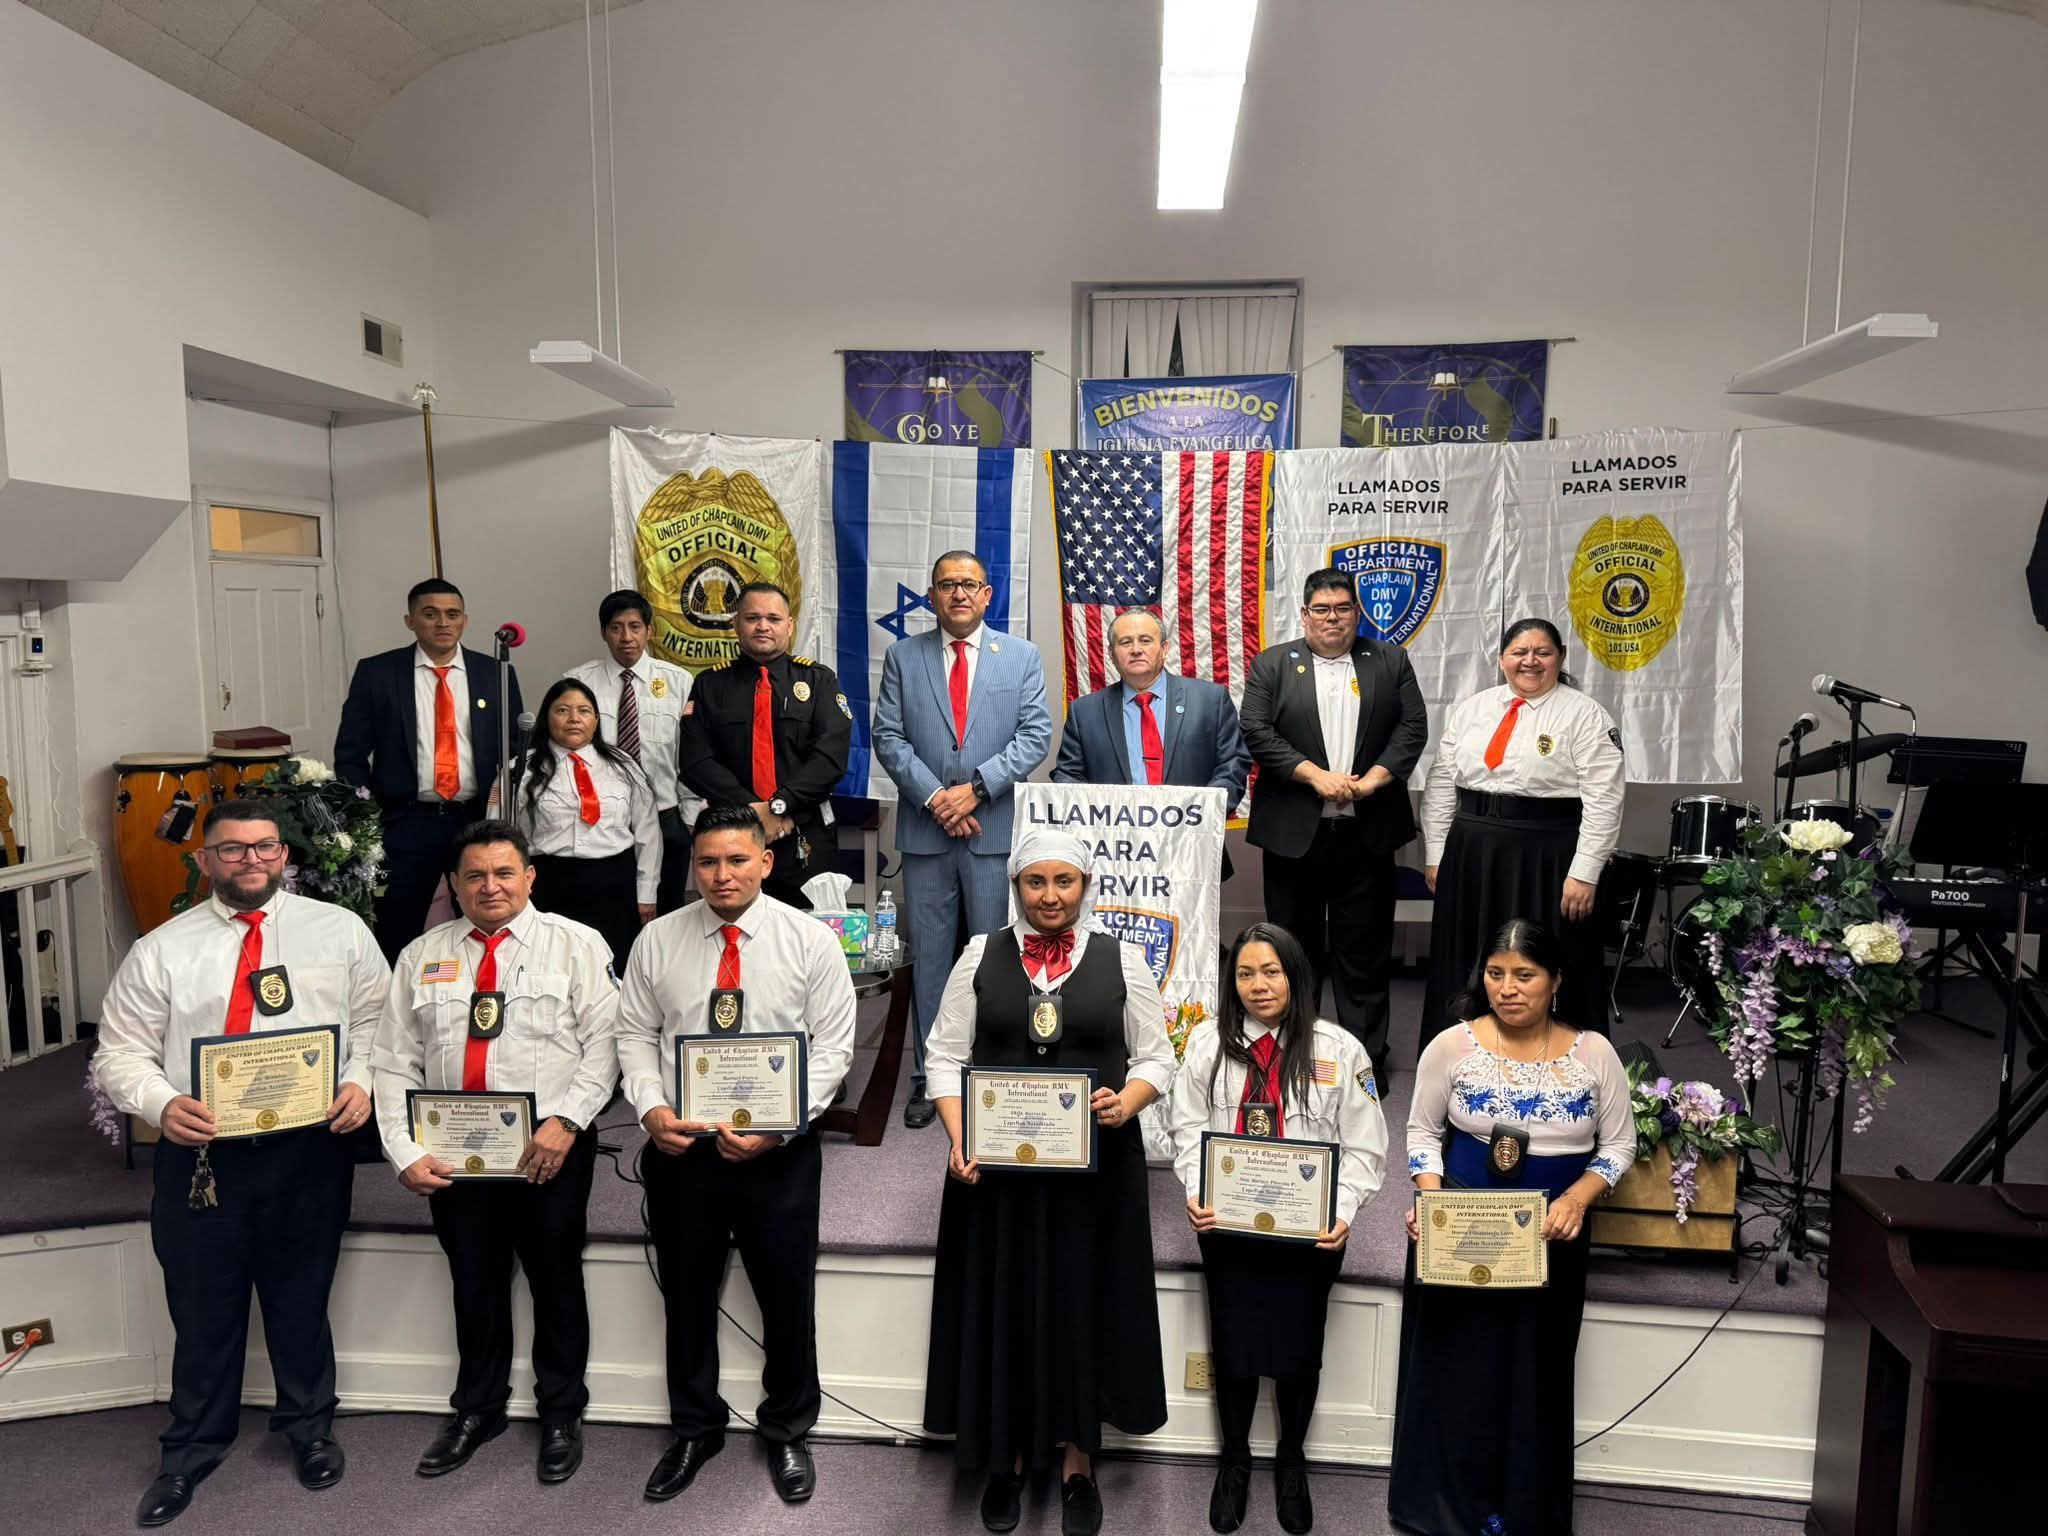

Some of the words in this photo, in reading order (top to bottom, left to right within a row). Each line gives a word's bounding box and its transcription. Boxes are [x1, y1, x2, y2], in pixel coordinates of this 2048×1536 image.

[1093, 386, 1280, 428] BIENVENIDOS
[1168, 415, 1178, 428] A
[1184, 415, 1204, 428] LA
[1097, 436, 1165, 451] IGLESIA
[1571, 455, 1678, 474] LLAMADOS
[1338, 479, 1441, 495] LLAMADOS
[1562, 479, 1613, 496] PARA
[1618, 475, 1687, 491] SERVIR
[1328, 501, 1376, 516] PARA
[1383, 500, 1449, 514] SERVIR
[657, 520, 689, 541] UNITED
[690, 513, 701, 527] OF
[702, 507, 747, 533] CHAPLAIN
[748, 522, 770, 543] DMV
[668, 532, 759, 564] OFFICIAL
[1345, 542, 1429, 559] OFFICIAL
[1587, 544, 1610, 561] UNITED
[1609, 542, 1618, 552] OF
[1618, 541, 1650, 554] CHAPLAIN
[1338, 556, 1435, 572] DEPARTMENT
[1594, 556, 1657, 573] OFFICIAL
[1360, 572, 1412, 586] CHAPLAIN
[1371, 588, 1399, 600] DMV
[1373, 603, 1393, 620] 02
[1386, 567, 1438, 646] TERNATIONAL
[1590, 615, 1662, 635] INTERNATIONAL
[662, 631, 742, 659] INTERNATIO
[1624, 642, 1640, 653] USA
[1029, 802, 1203, 827] LLAMADOS
[1099, 874, 1170, 897] RVIR
[1931, 890, 1969, 901] Pa700
[1089, 911, 1159, 931] FICIAL
